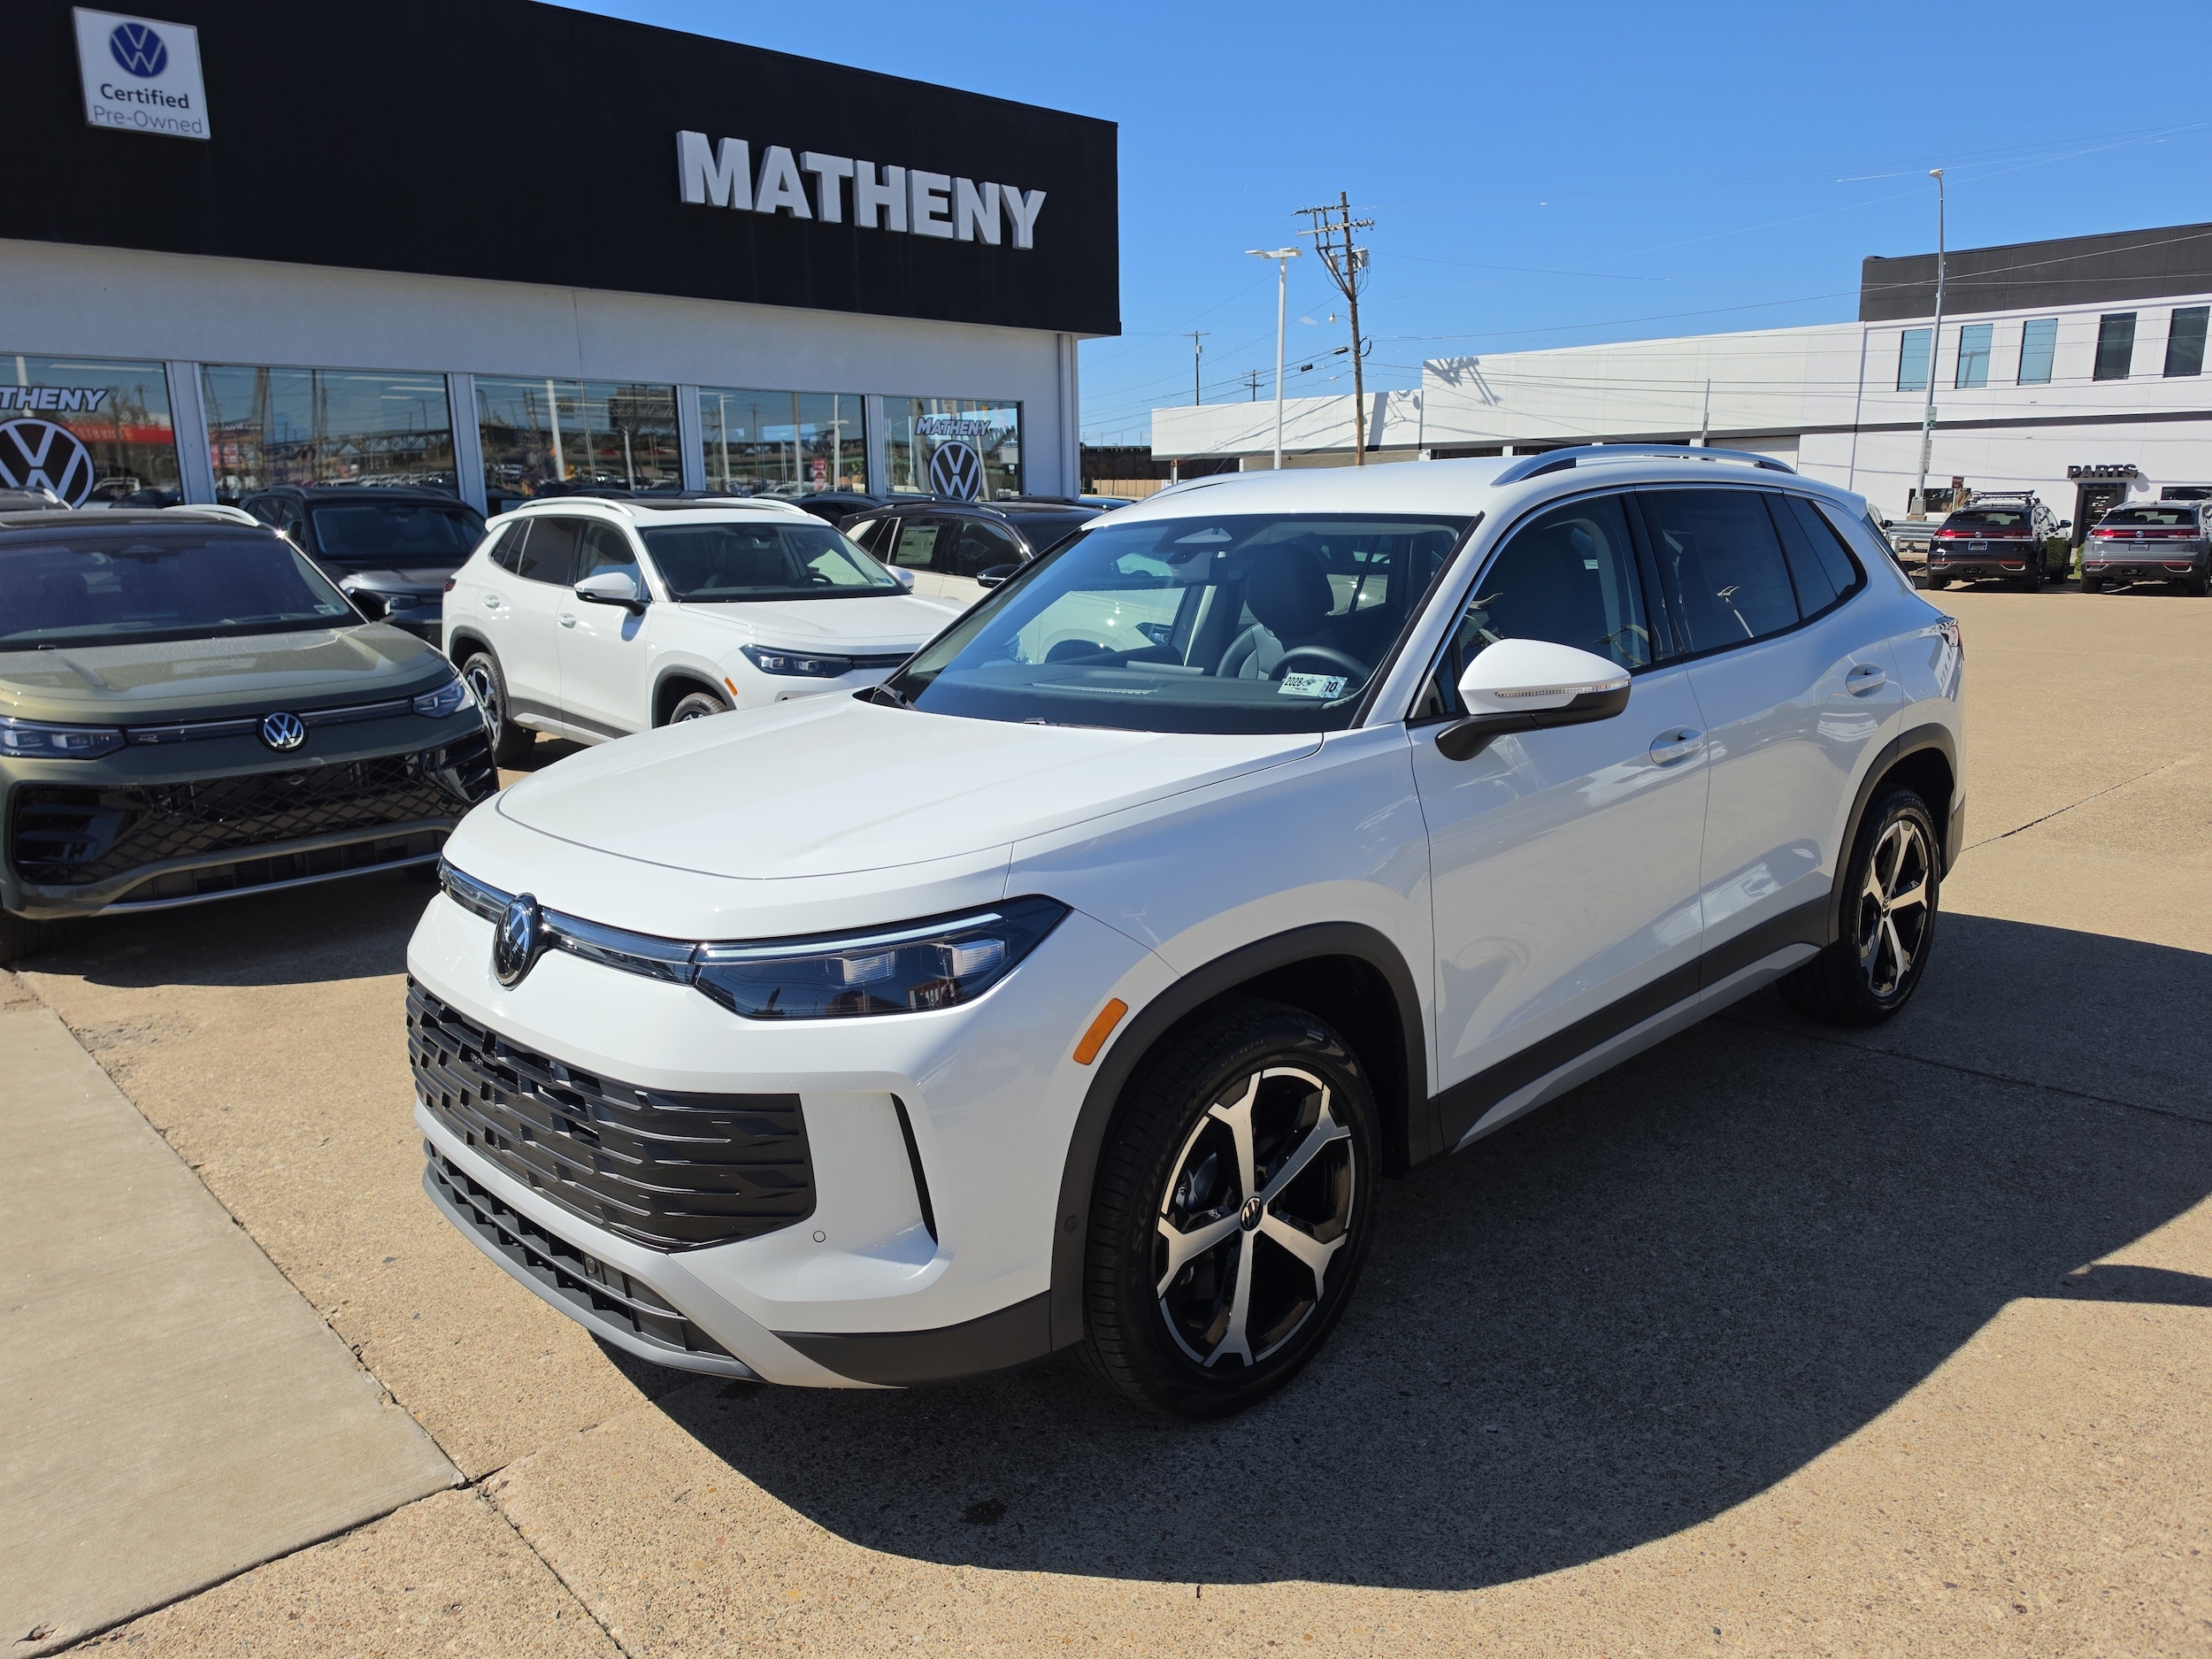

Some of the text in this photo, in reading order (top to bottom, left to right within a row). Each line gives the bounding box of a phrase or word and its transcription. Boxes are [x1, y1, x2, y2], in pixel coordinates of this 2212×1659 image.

[100, 83, 190, 109] Certified
[93, 105, 203, 134] Pre-Owned
[676, 130, 1048, 250] MATHENY
[916, 417, 991, 436] MATHENY
[2066, 464, 2139, 480] PARTS
[1324, 680, 1339, 693] 10
